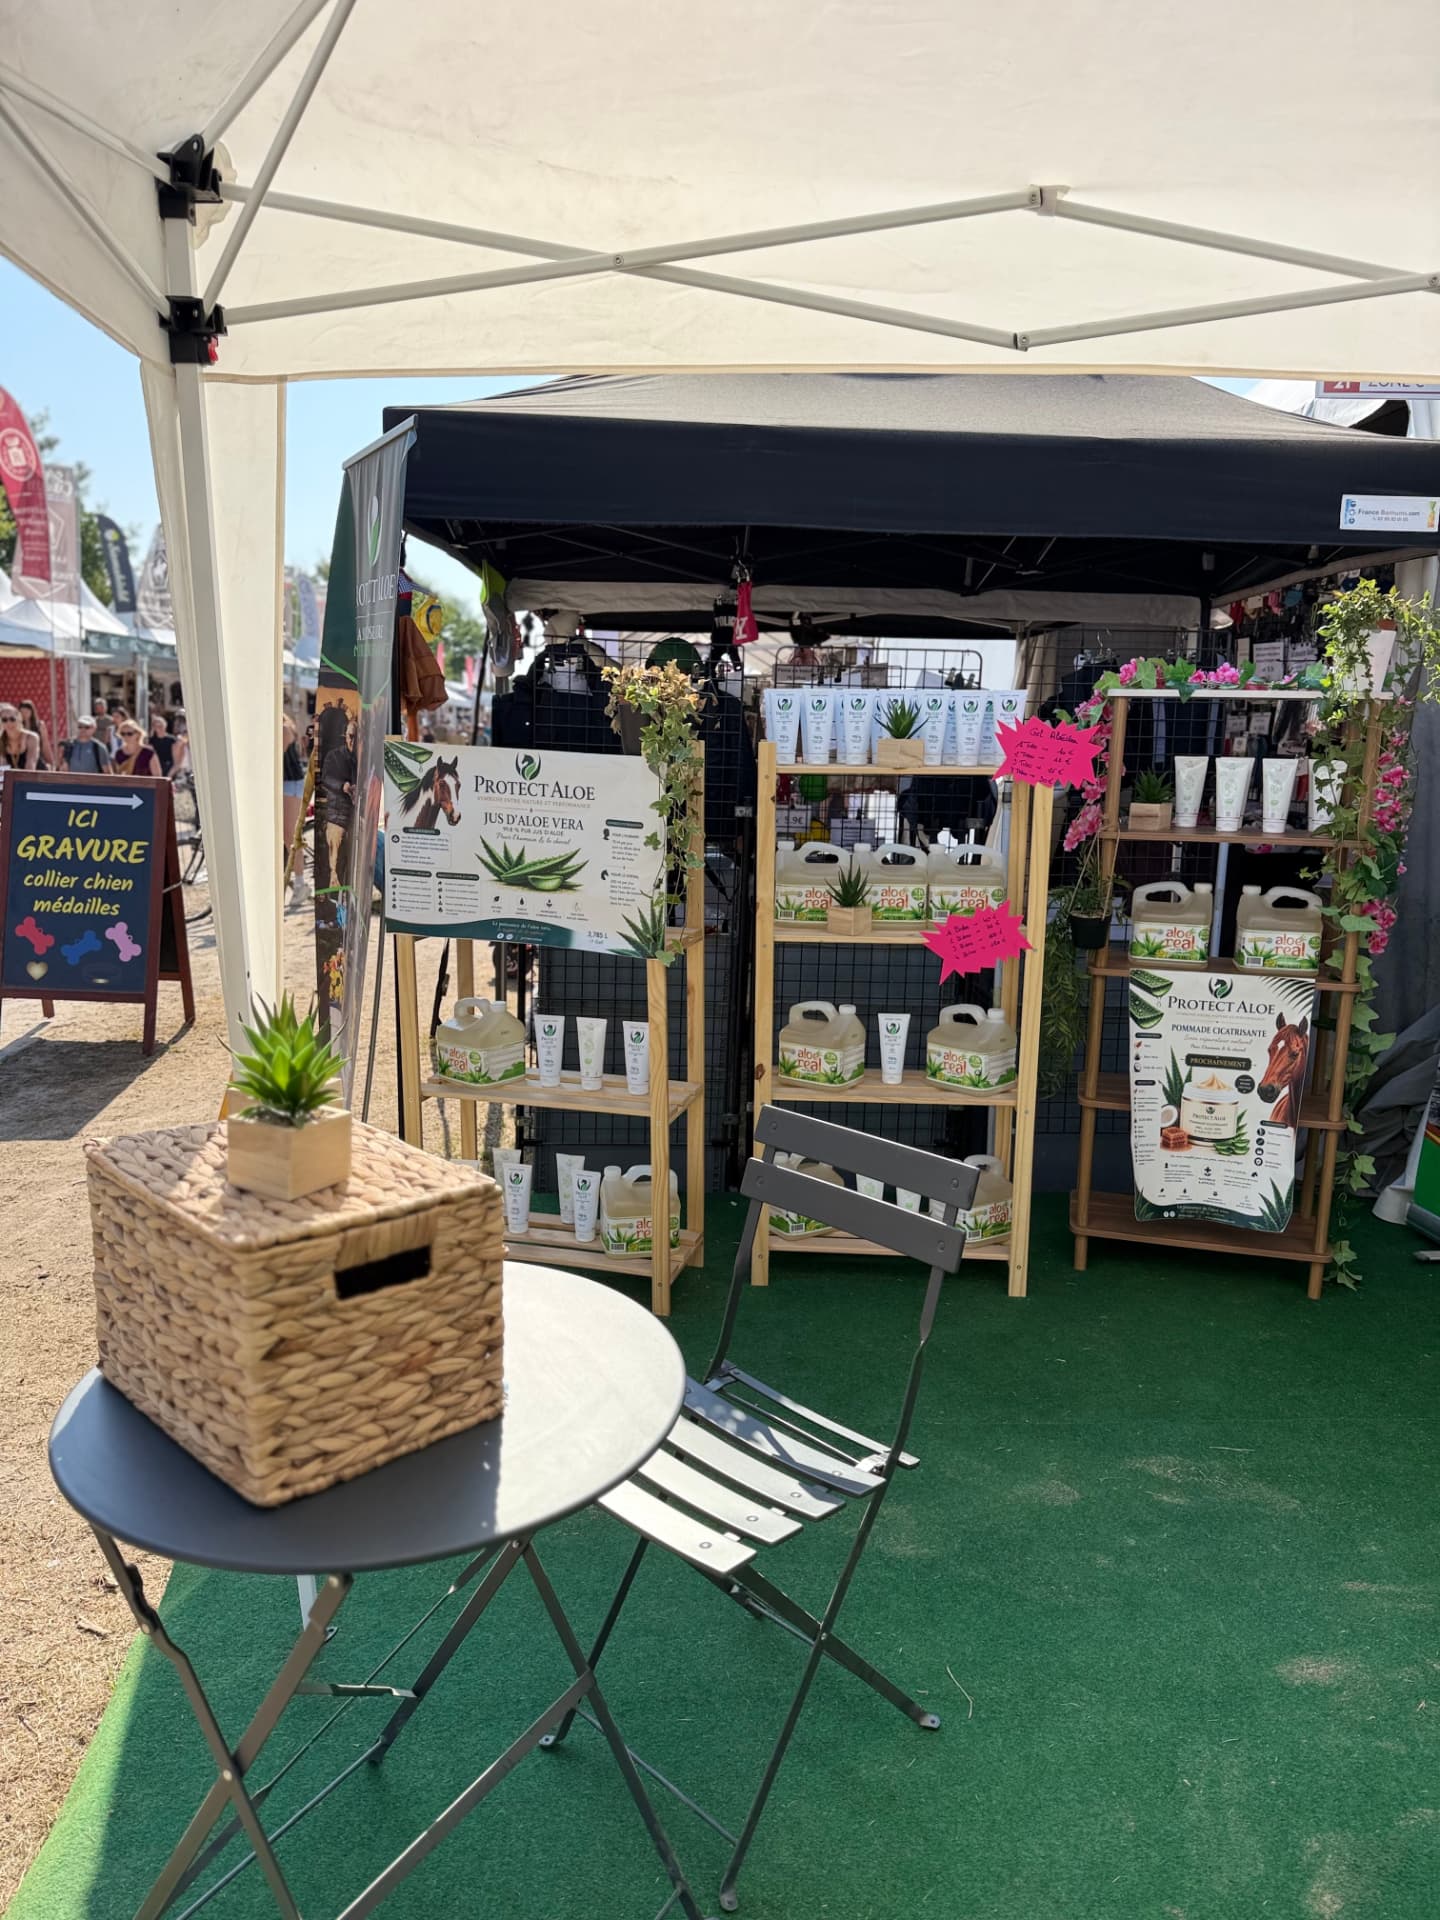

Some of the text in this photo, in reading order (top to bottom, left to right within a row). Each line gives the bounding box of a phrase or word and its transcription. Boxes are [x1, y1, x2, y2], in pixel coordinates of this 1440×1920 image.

[474, 775, 595, 801] PROTECT ALOE
[67, 809, 98, 828] ICI
[483, 812, 584, 831] JUS D'ALOE VERA
[16, 835, 150, 864] GRAVURE
[23, 869, 134, 891] collier chien
[880, 886, 906, 898] aloe
[960, 886, 986, 898] aloe
[33, 896, 120, 916] médailles
[880, 894, 909, 908] real
[960, 895, 989, 909] real
[1166, 927, 1192, 939] aloe
[1275, 933, 1302, 946] aloe
[1165, 936, 1195, 950] real
[1275, 942, 1306, 957] real
[1168, 995, 1276, 1015] PROTECT ALOE
[1171, 1024, 1267, 1038] POMMADE CICATRISANTE
[797, 1048, 819, 1060] aloe
[797, 1057, 822, 1073] real
[1190, 1057, 1247, 1069] PROCHAINEMENT
[636, 1216, 652, 1229] alo
[636, 1229, 652, 1239] re
